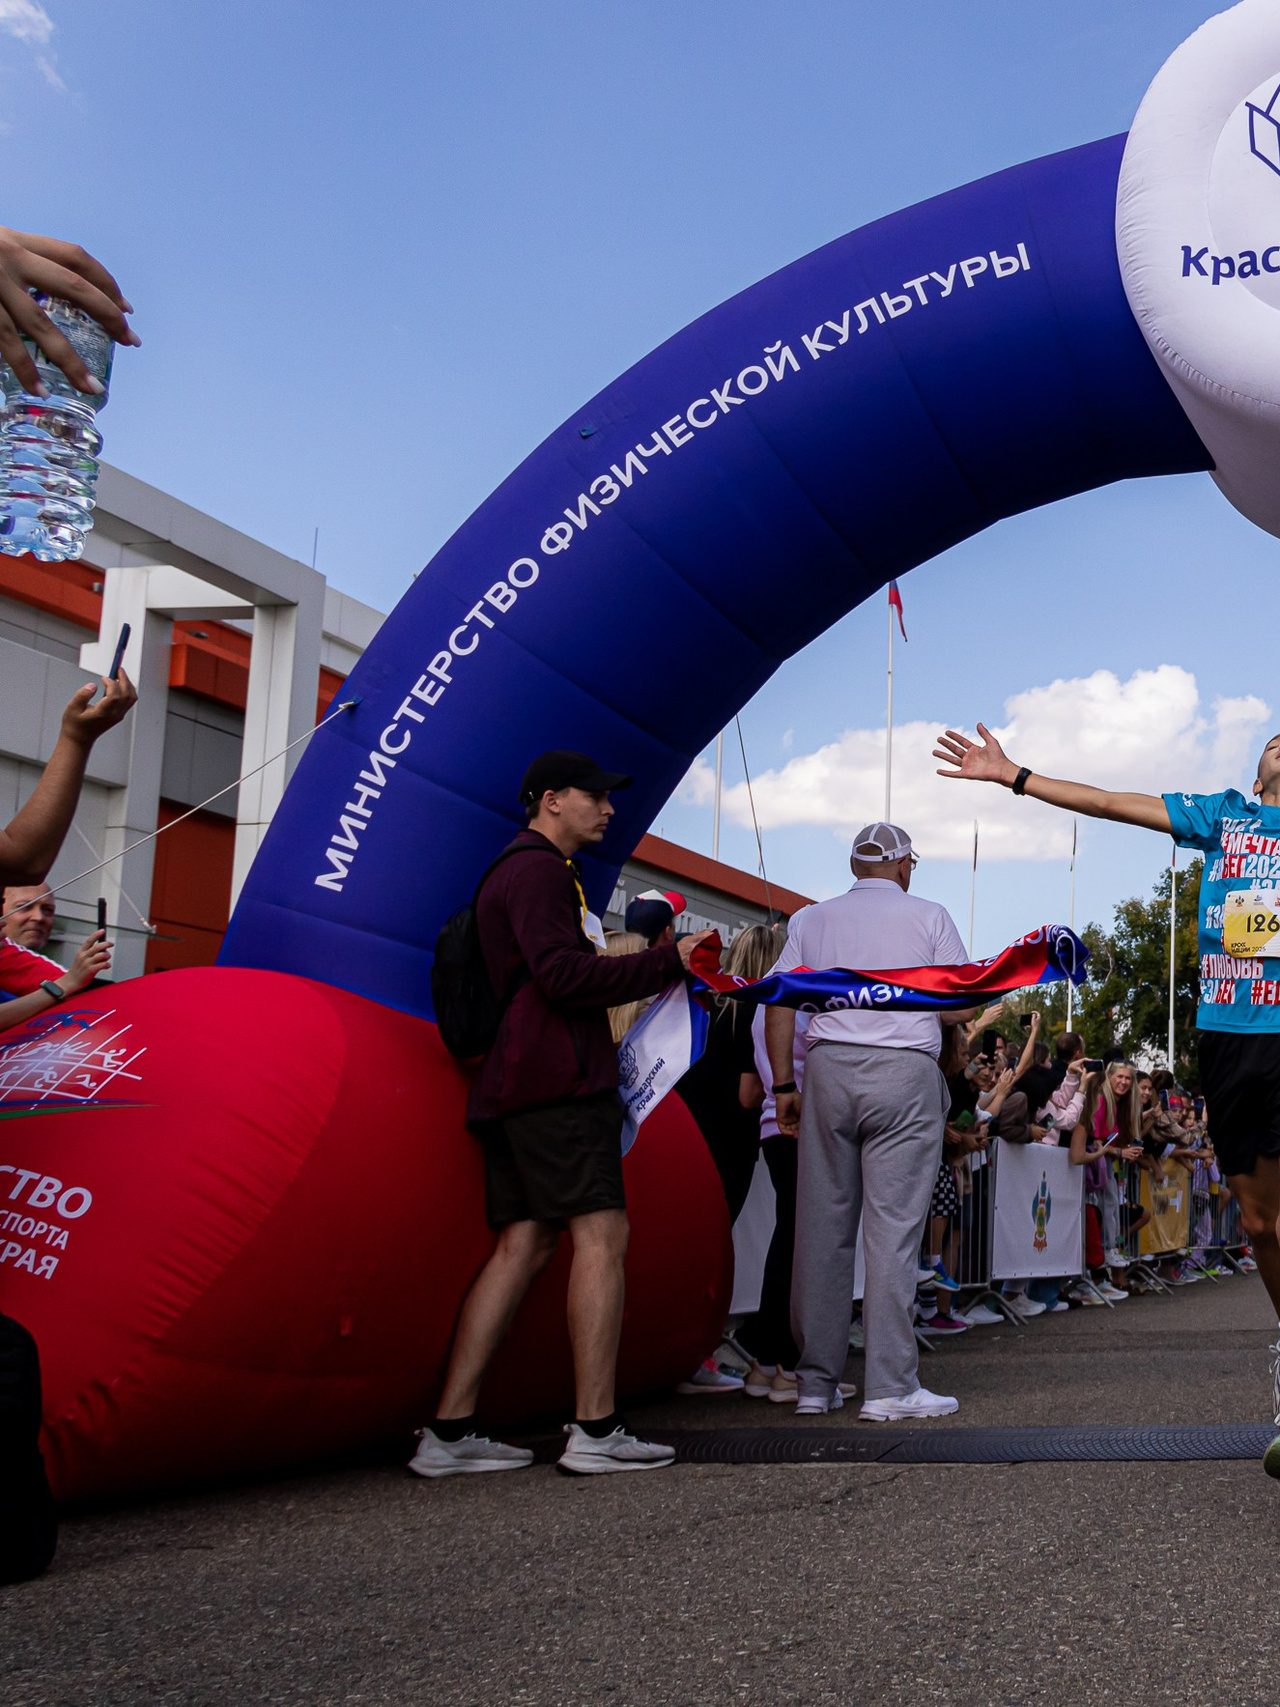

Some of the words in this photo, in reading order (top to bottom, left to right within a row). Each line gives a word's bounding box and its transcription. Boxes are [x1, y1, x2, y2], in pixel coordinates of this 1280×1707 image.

[314, 557, 539, 892] МИНИСТЕРСТВО
[539, 339, 801, 556] ФИЗИЧЕСКОЙ
[801, 242, 1030, 359] КУЛЬТУРЫ
